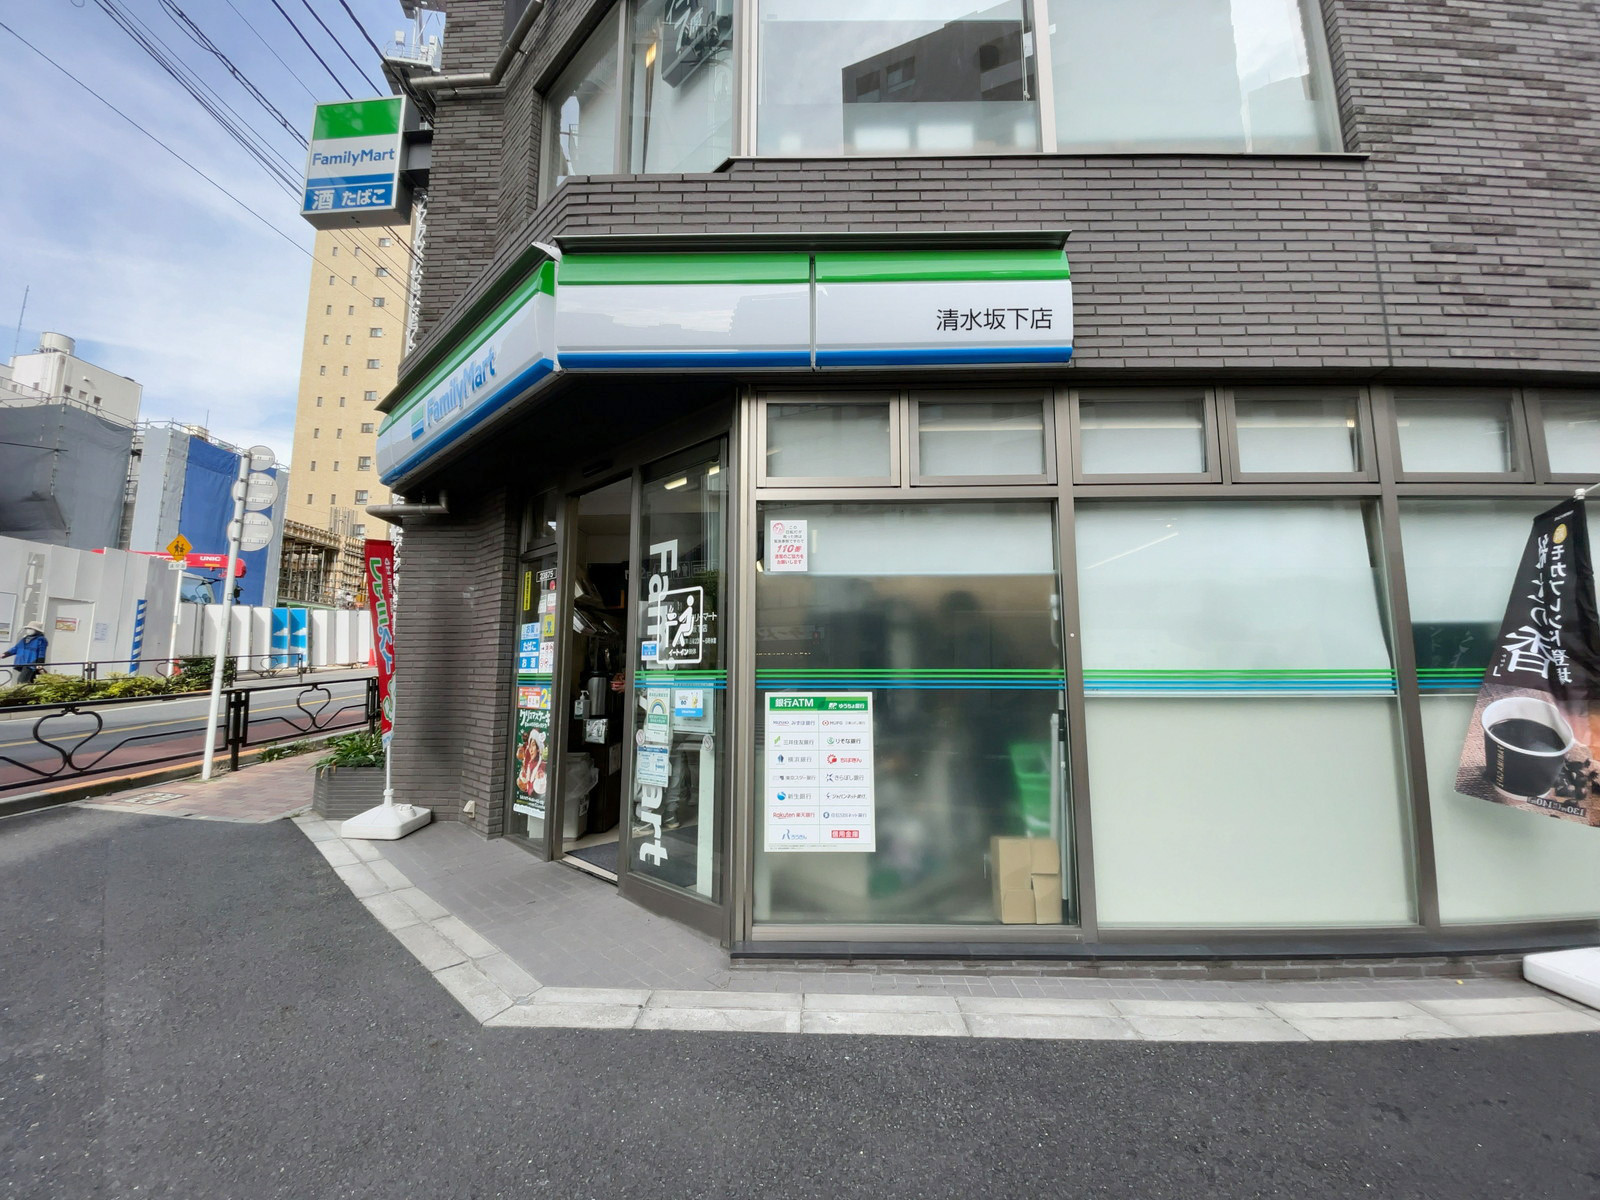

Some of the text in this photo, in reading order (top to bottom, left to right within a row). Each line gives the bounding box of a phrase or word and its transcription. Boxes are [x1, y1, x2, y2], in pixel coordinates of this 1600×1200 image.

[312, 148, 395, 166] FamilyMart
[312, 188, 386, 210] 酒 たばこ
[936, 307, 1053, 331] 清水坂下店
[426, 347, 497, 428] FamilyMart
[522, 641, 537, 652] たばこ
[775, 698, 815, 707] 銀行ATM
